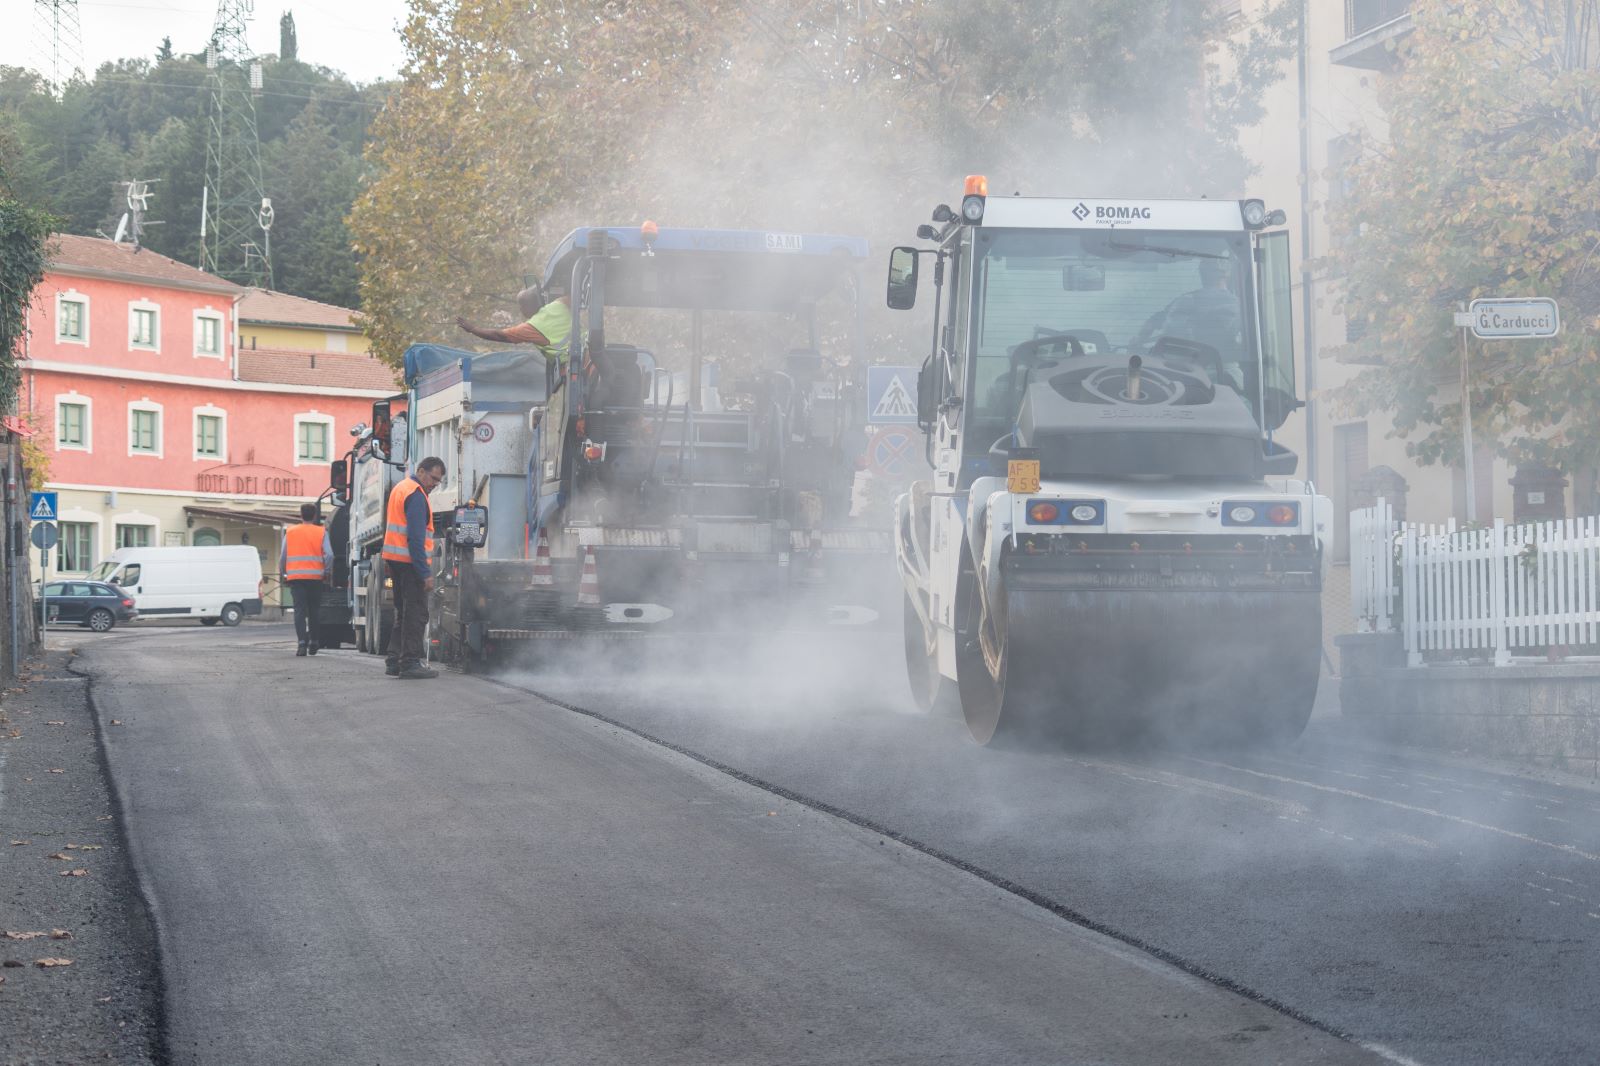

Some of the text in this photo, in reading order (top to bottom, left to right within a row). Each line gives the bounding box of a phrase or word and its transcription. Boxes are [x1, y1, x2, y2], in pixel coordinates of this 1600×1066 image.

[1096, 206, 1151, 219] BOMAG
[767, 234, 801, 249] SAMI
[197, 473, 304, 496] HOTEL DEI CONTI
[1008, 477, 1039, 491] 759
